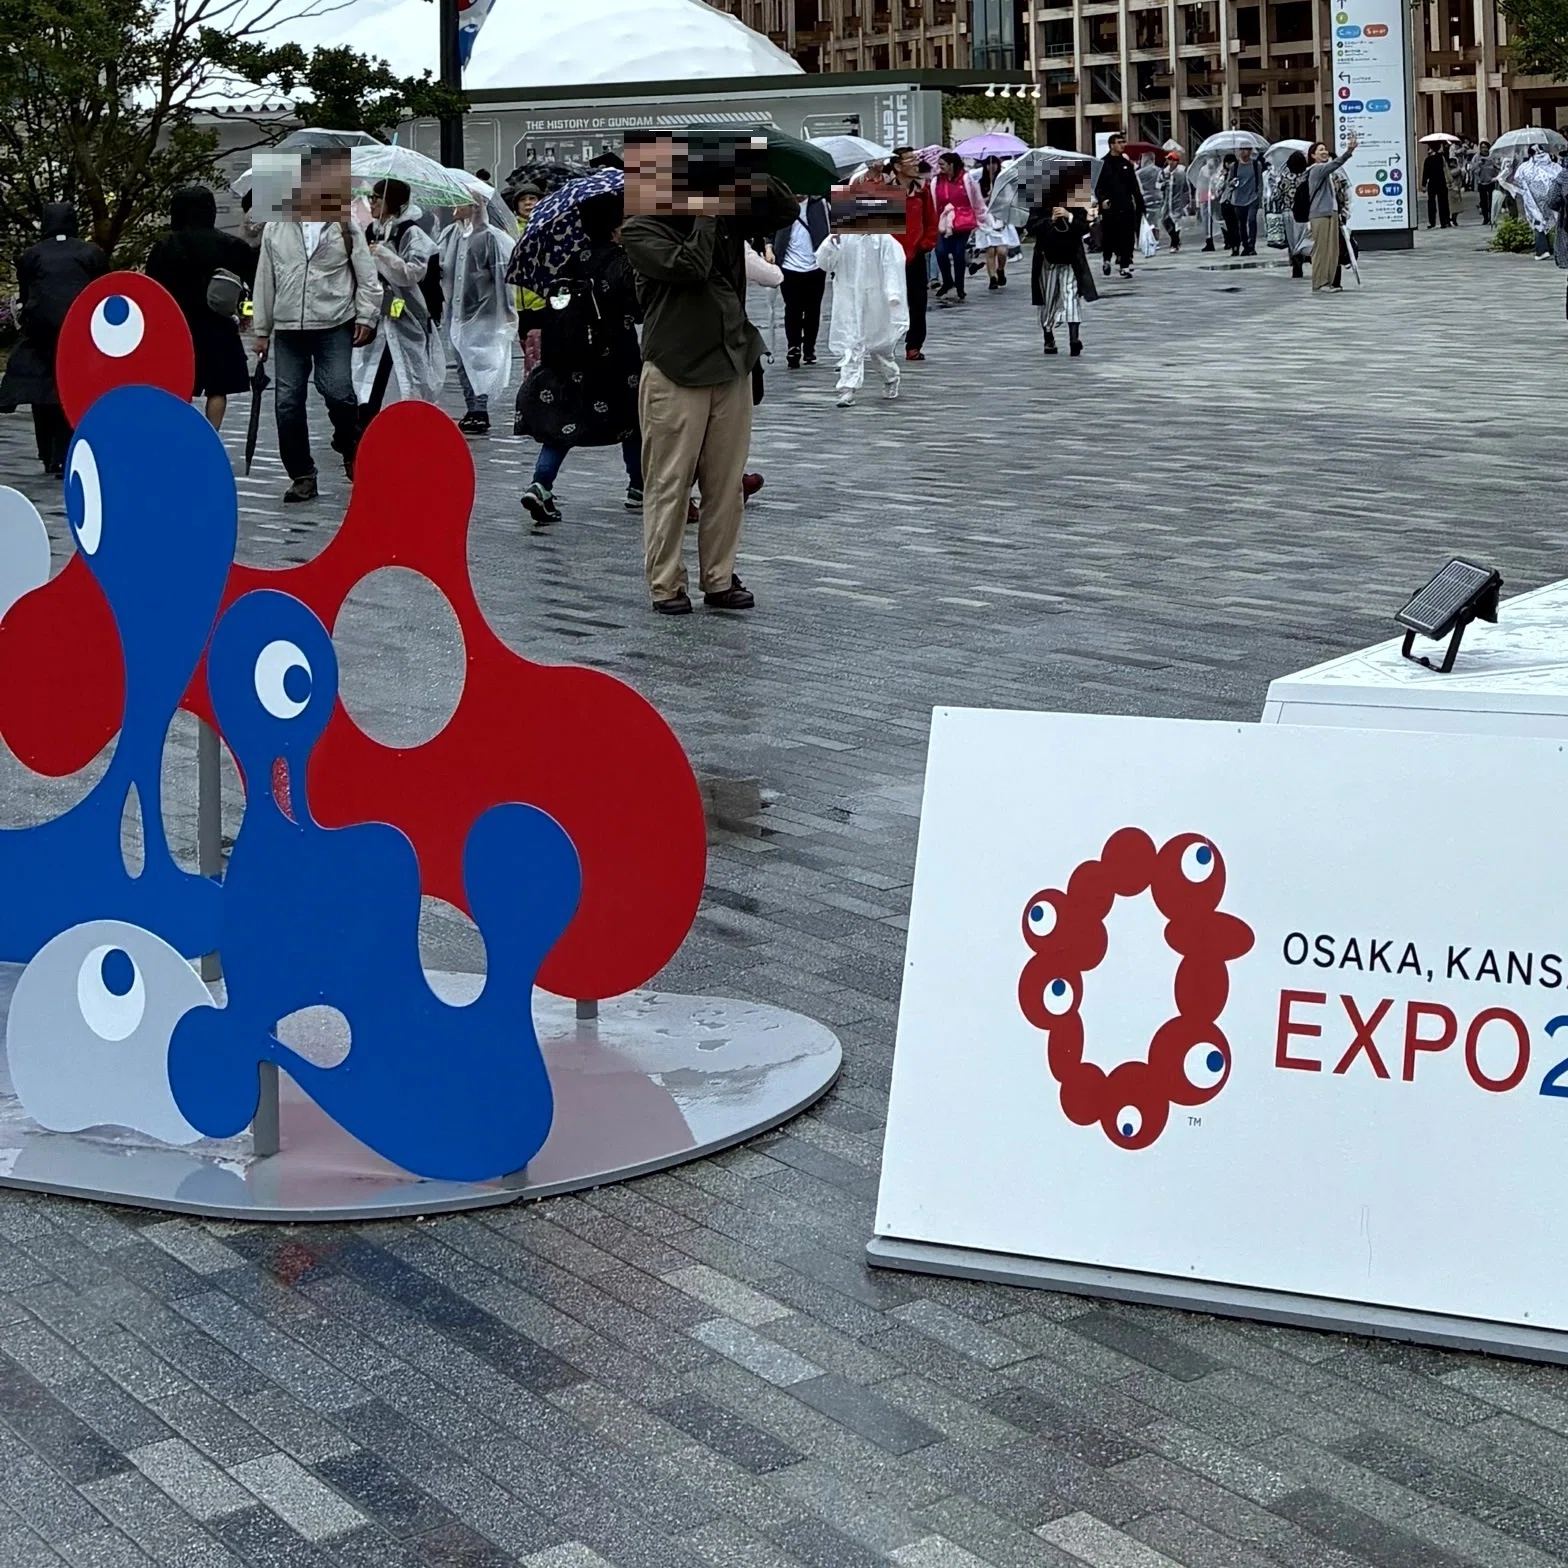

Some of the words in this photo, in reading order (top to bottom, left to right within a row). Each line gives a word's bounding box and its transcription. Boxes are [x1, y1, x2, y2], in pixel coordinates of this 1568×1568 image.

[525, 120, 545, 130] THE
[546, 118, 589, 130] HISTORY
[592, 117, 605, 128] OF
[607, 116, 653, 127] GUNDAM
[1283, 931, 1433, 983] OSAKA,
[1187, 1116, 1202, 1127] TM
